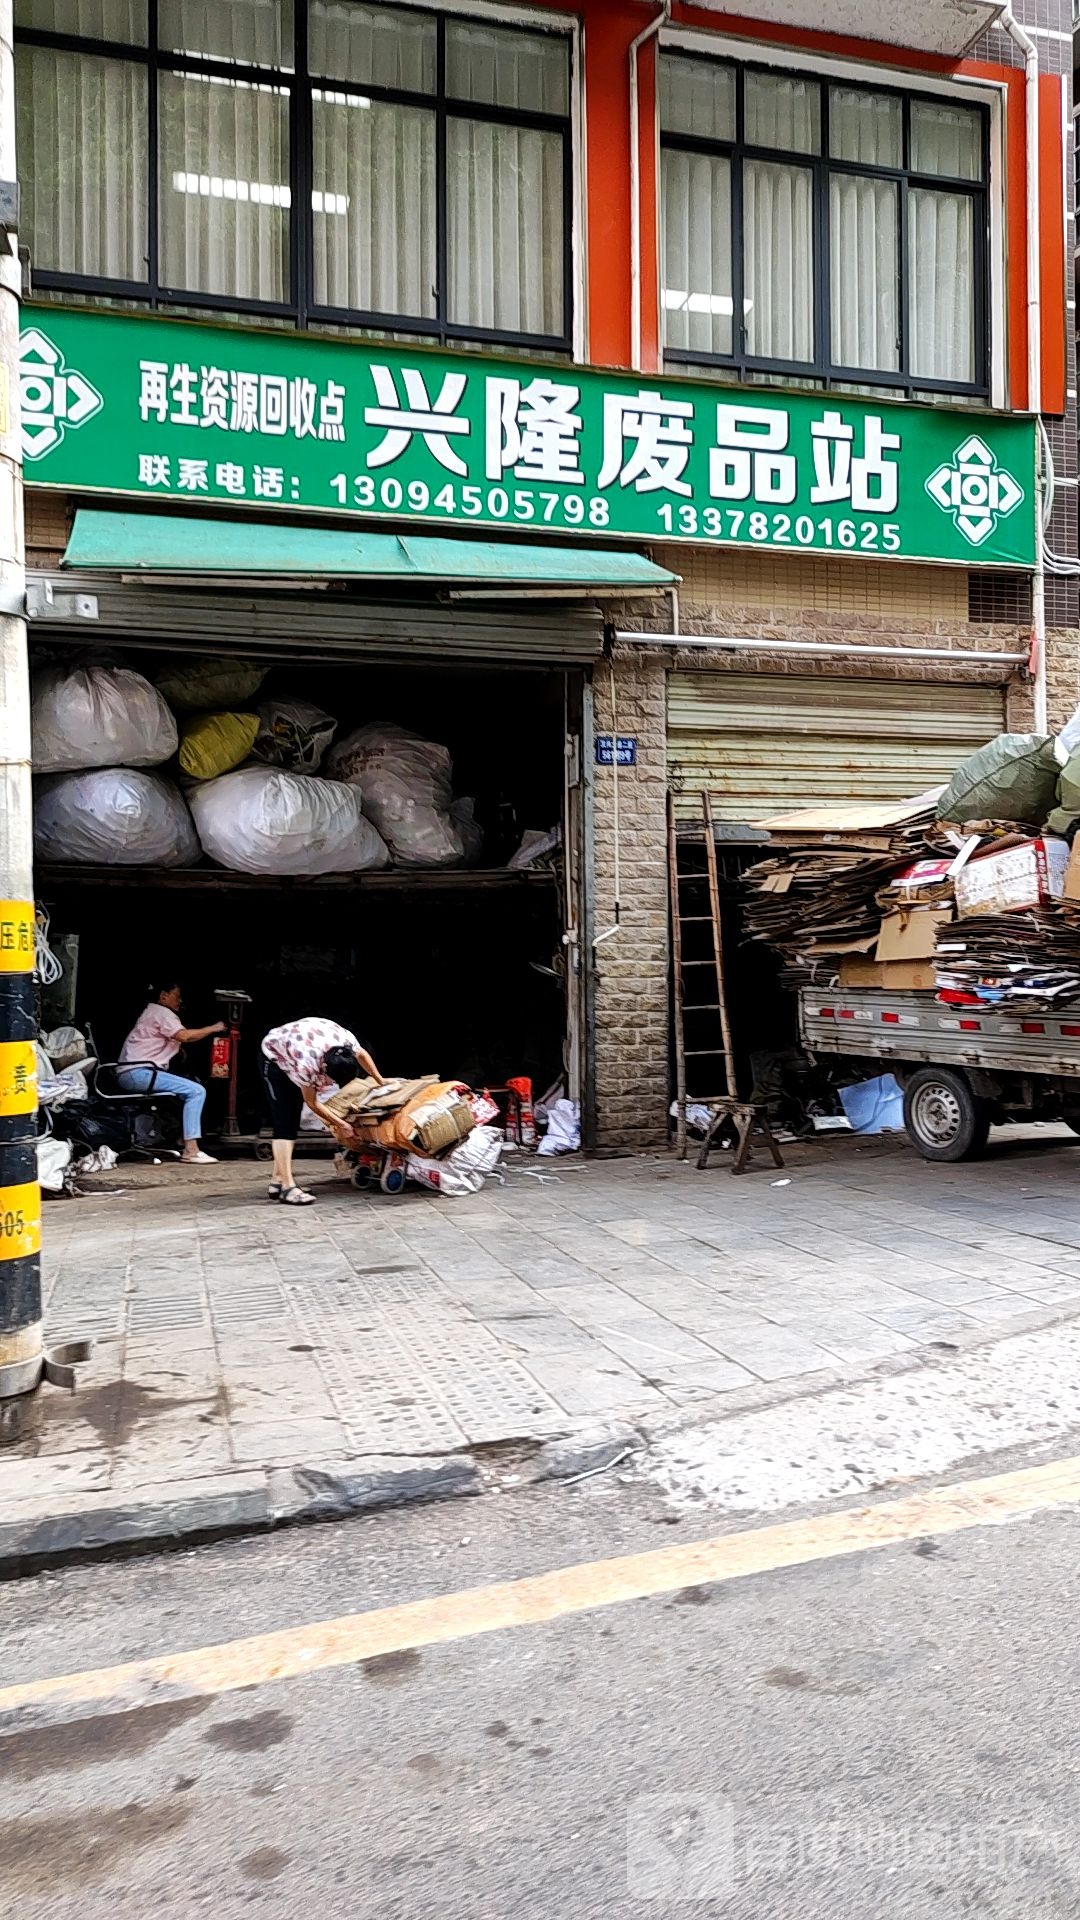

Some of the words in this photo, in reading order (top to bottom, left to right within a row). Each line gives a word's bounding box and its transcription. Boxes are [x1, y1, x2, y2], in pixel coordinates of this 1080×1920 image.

[138, 360, 346, 442] 再生资源回收点
[364, 364, 901, 514] 兴隆废品站
[330, 473, 610, 527] 13094505798
[656, 503, 901, 552] 13378201625
[0, 1210, 24, 1238] 05
